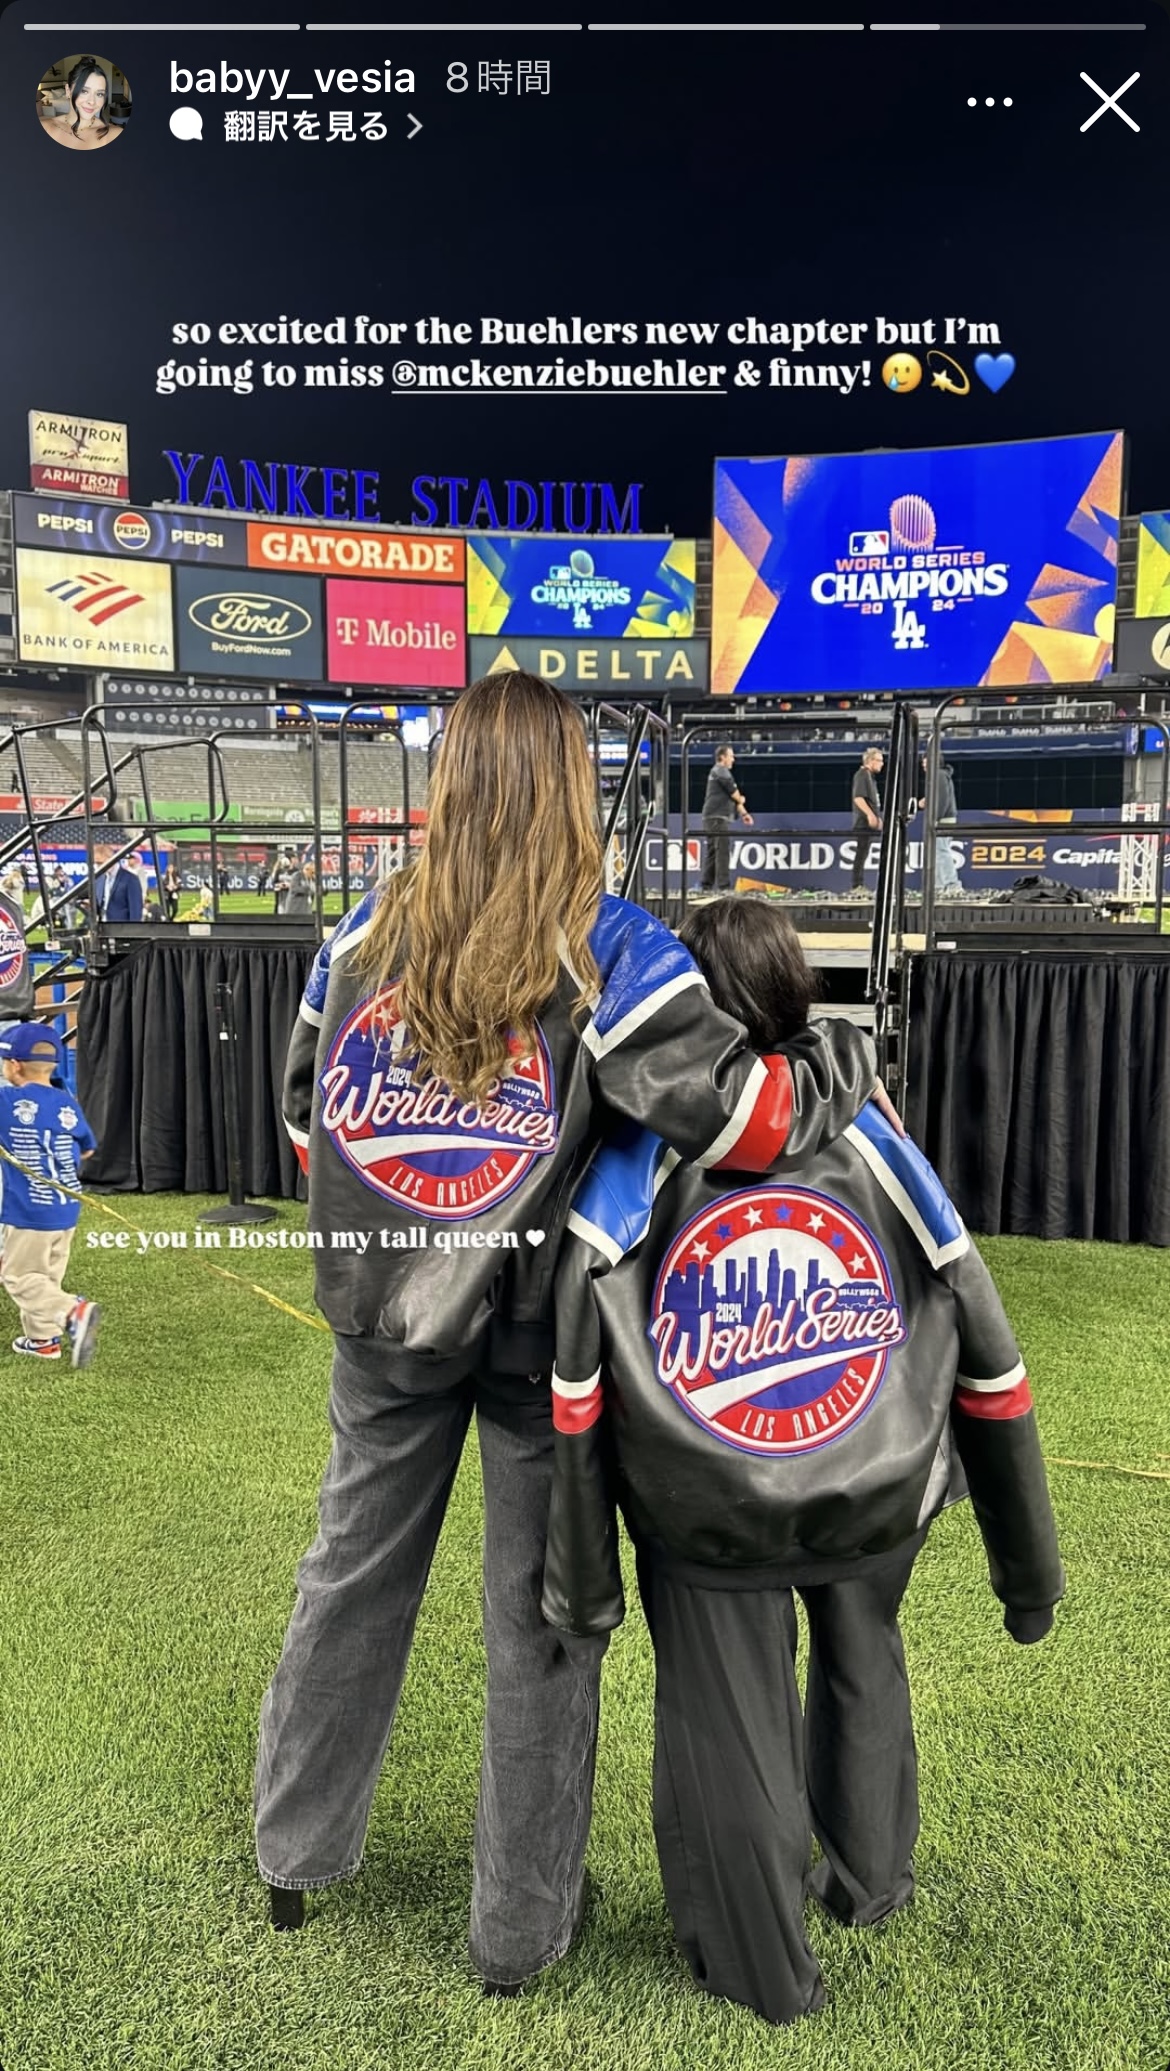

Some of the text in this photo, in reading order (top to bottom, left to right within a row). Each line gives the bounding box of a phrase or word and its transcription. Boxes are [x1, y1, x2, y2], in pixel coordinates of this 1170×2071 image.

[36, 420, 121, 442] ARMITRON
[42, 468, 119, 489] ARMITRON
[162, 450, 644, 535] YANKEE STADIUM
[37, 513, 94, 534] PEPSI
[116, 524, 148, 537] PEPSI
[171, 529, 224, 548] PEPSI
[261, 531, 455, 573] GATORADE
[835, 551, 986, 572] WORLD SERIES
[810, 563, 1010, 605] CHAMPIONS
[530, 585, 632, 606] CHAMPIONS
[210, 598, 291, 635] Ford
[860, 598, 956, 615] 20 24
[336, 617, 457, 651] T Mobile
[891, 600, 930, 650] LA
[23, 633, 170, 656] BANK OF AMERICA
[211, 641, 292, 657] BuyFordNow.com
[539, 649, 694, 680] DELTA
[971, 845, 1046, 863] 2024
[1052, 848, 1123, 868] Capita
[386, 1065, 412, 1086] 2024
[388, 1159, 504, 1206] LOS ANGELES
[715, 1302, 742, 1323] 2024
[650, 1287, 903, 1383] World Series
[739, 1366, 866, 1440] LOS ANGELES
